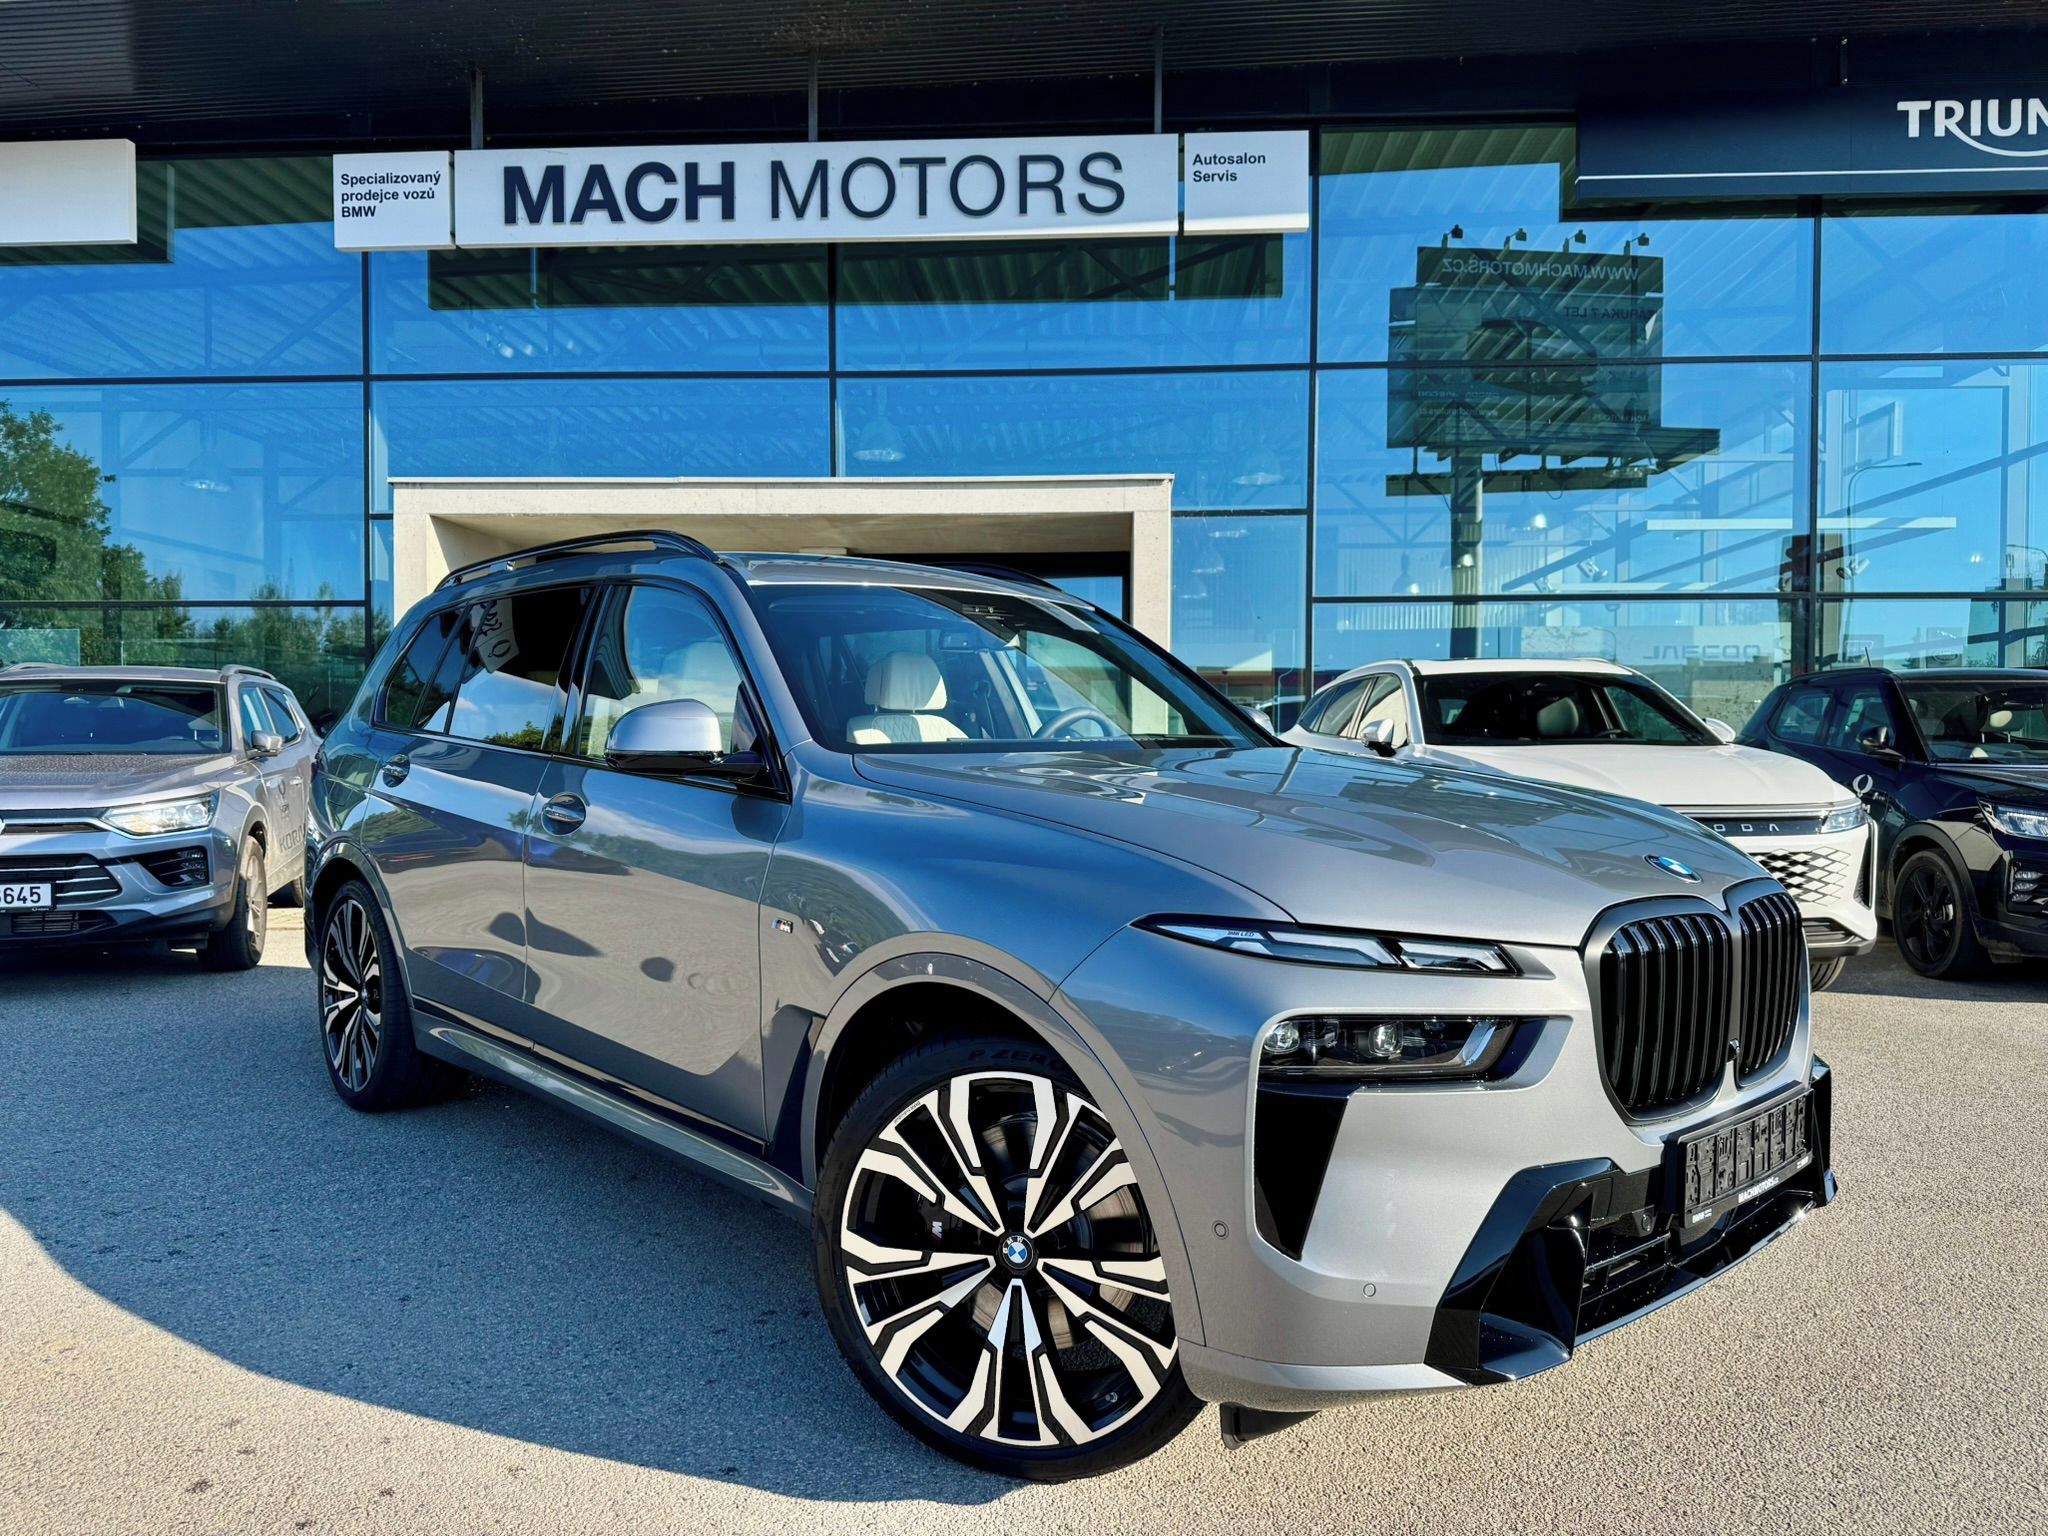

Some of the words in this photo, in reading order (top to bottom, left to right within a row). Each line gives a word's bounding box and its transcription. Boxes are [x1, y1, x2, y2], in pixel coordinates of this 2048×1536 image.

[1192, 152, 1266, 166] Autosalon
[340, 170, 441, 188] Specializovaný
[1192, 169, 1238, 183] Servis
[341, 188, 399, 205] prodejce
[402, 187, 435, 200] vozů
[504, 161, 736, 226] MACH
[770, 151, 1126, 220] MOTORS
[341, 205, 376, 218] BMW
[1712, 822, 1781, 833] ODA
[0, 886, 41, 905] 645
